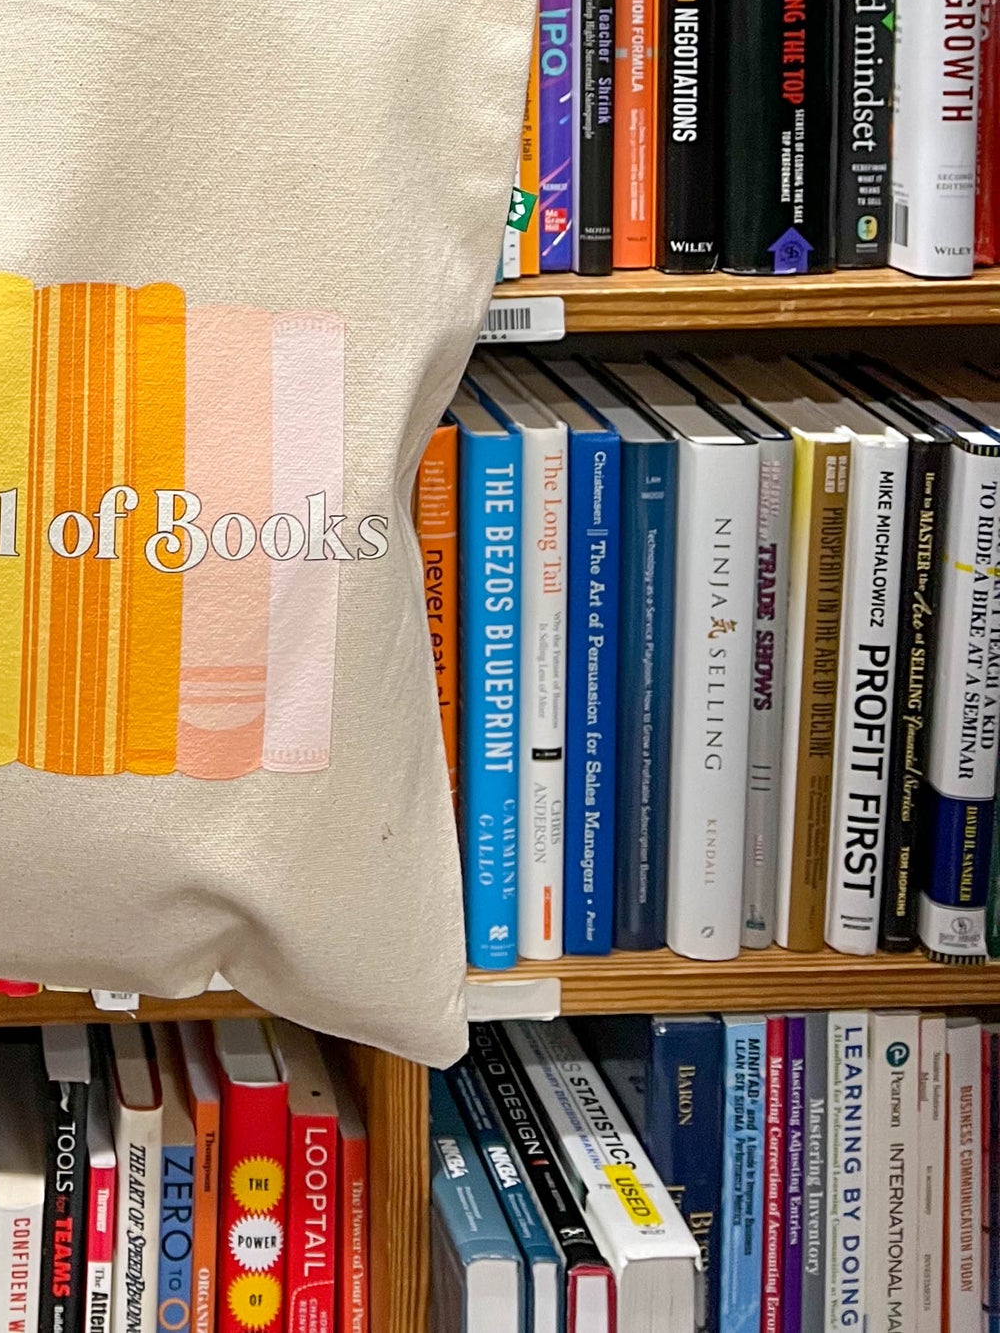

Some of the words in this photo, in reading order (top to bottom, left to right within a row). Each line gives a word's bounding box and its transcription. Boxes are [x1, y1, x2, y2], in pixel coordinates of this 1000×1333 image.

[672, 9, 699, 143] NEGOTIATIONS
[782, 29, 806, 64] THE
[782, 69, 806, 104] TOP
[852, 24, 885, 153] mindset
[670, 240, 714, 253] WILEY
[934, 246, 972, 256] WILEY
[484, 463, 514, 514] THE
[543, 450, 563, 492] The
[877, 471, 894, 510] MIKE
[47, 484, 140, 562] of
[142, 489, 390, 575] Books
[537, 498, 563, 551] Long
[484, 526, 514, 613] BEZOS
[542, 556, 563, 595] Tail
[709, 517, 732, 609] NINJA
[870, 515, 892, 628] MICHALOWICZ
[484, 623, 514, 774] BLUEPRINT
[850, 643, 891, 781] PROFIT
[842, 792, 881, 899] FIRST
[843, 1026, 863, 1175] LEARNING
[56, 1122, 75, 1192] TOOLS
[248, 1178, 269, 1191] THE
[303, 1127, 328, 1277] LOOPTAIL
[614, 1176, 652, 1218] USED
[843, 1188, 861, 1221] BY
[9, 1217, 31, 1314] CONFIDENT
[53, 1218, 73, 1298] TEAMS
[237, 1235, 277, 1249] POWER
[249, 1293, 262, 1306] OF
[841, 1235, 860, 1326] DOING
